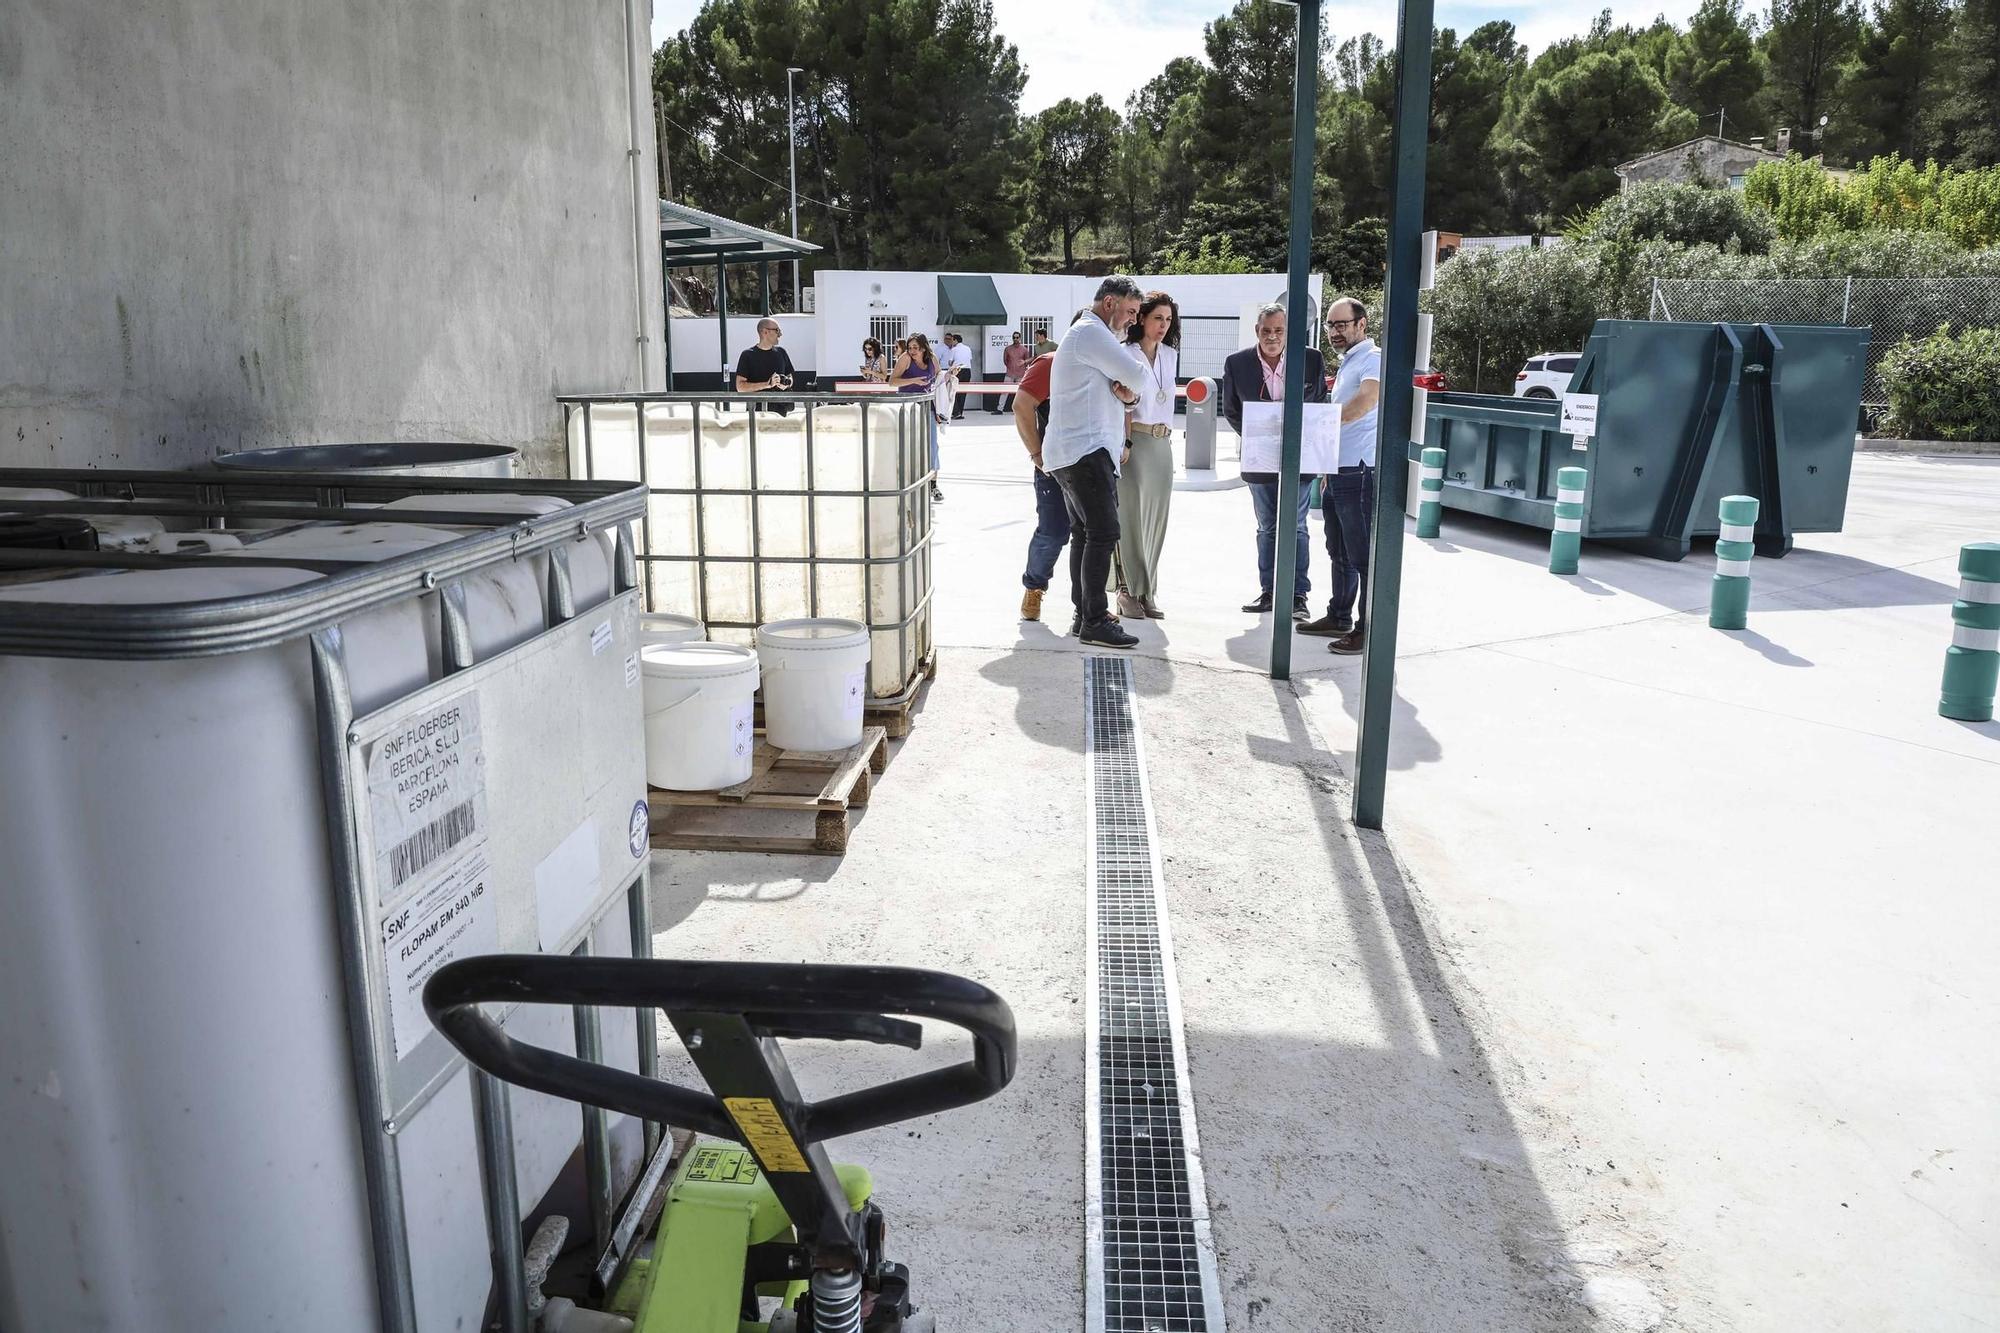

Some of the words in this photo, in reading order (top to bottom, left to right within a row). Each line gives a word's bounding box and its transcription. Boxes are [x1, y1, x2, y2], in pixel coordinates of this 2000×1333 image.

[384, 735, 404, 760] SNF
[388, 910, 409, 940] SNF
[401, 922, 438, 961] FLOPAM
[439, 908, 454, 928] EM
